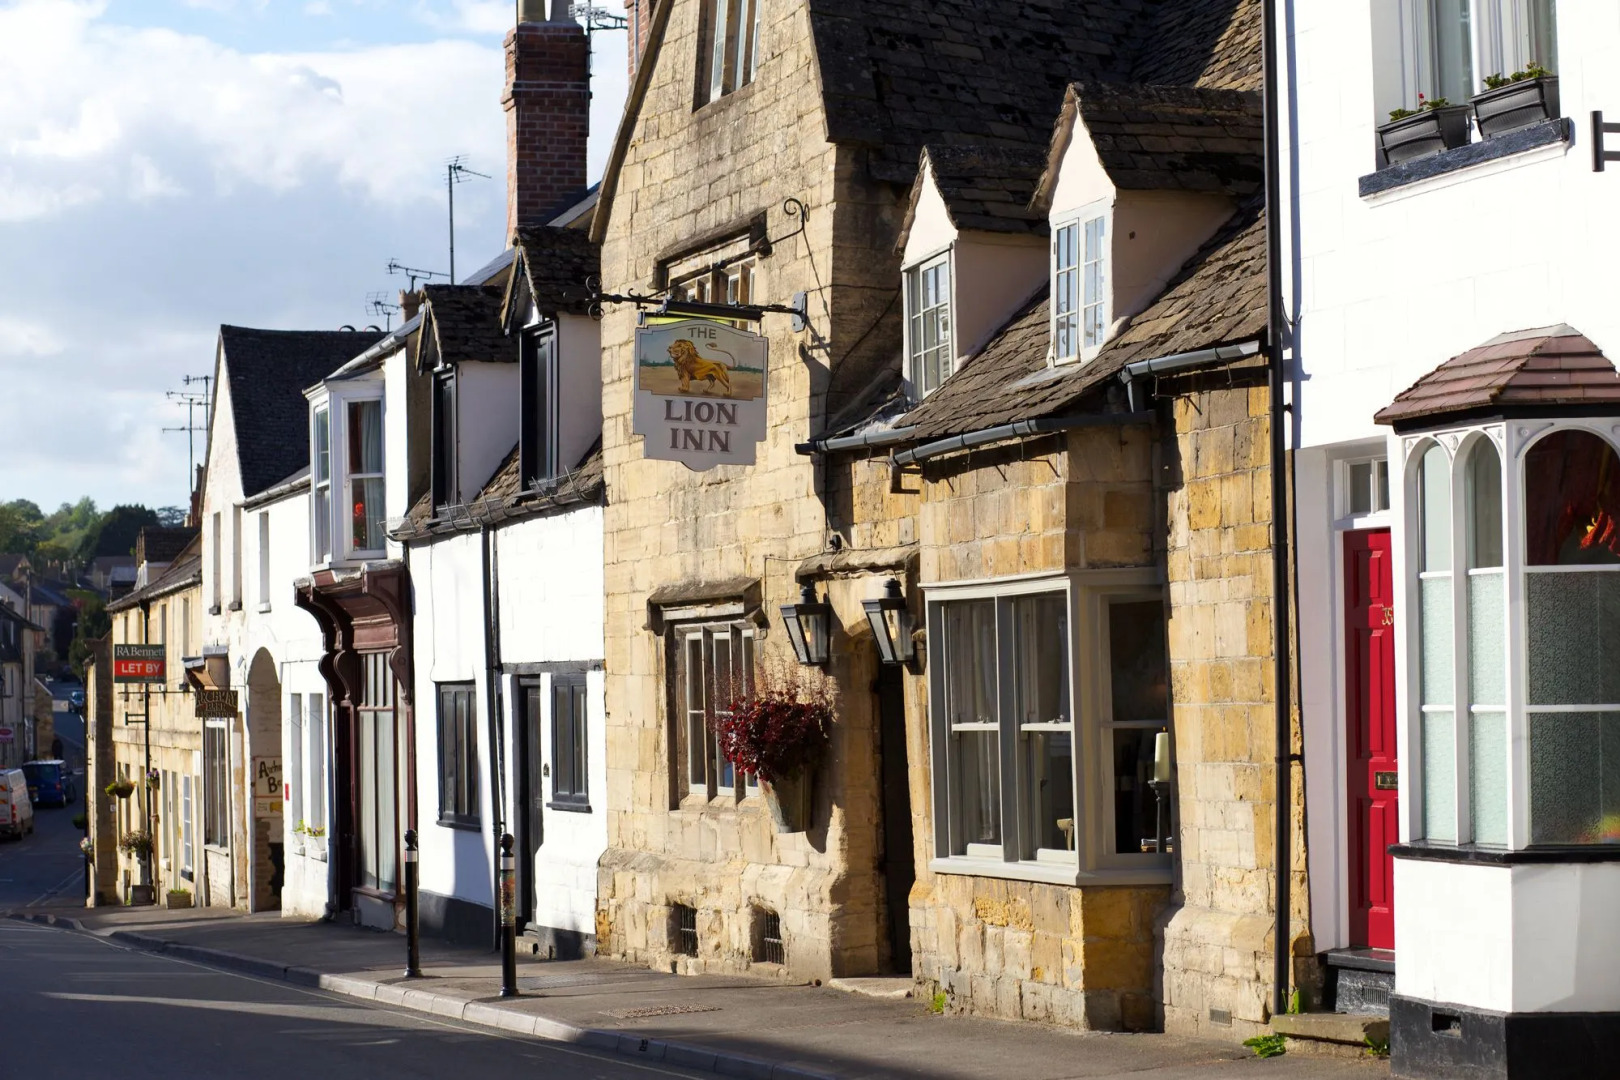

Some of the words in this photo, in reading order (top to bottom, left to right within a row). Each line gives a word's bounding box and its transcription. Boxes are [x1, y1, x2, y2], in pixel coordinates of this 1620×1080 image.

[688, 327, 717, 340] THE
[664, 399, 738, 426] LION
[670, 428, 730, 453] INN
[131, 646, 164, 657] Bennett
[121, 663, 143, 673] LET
[146, 663, 161, 673] BY
